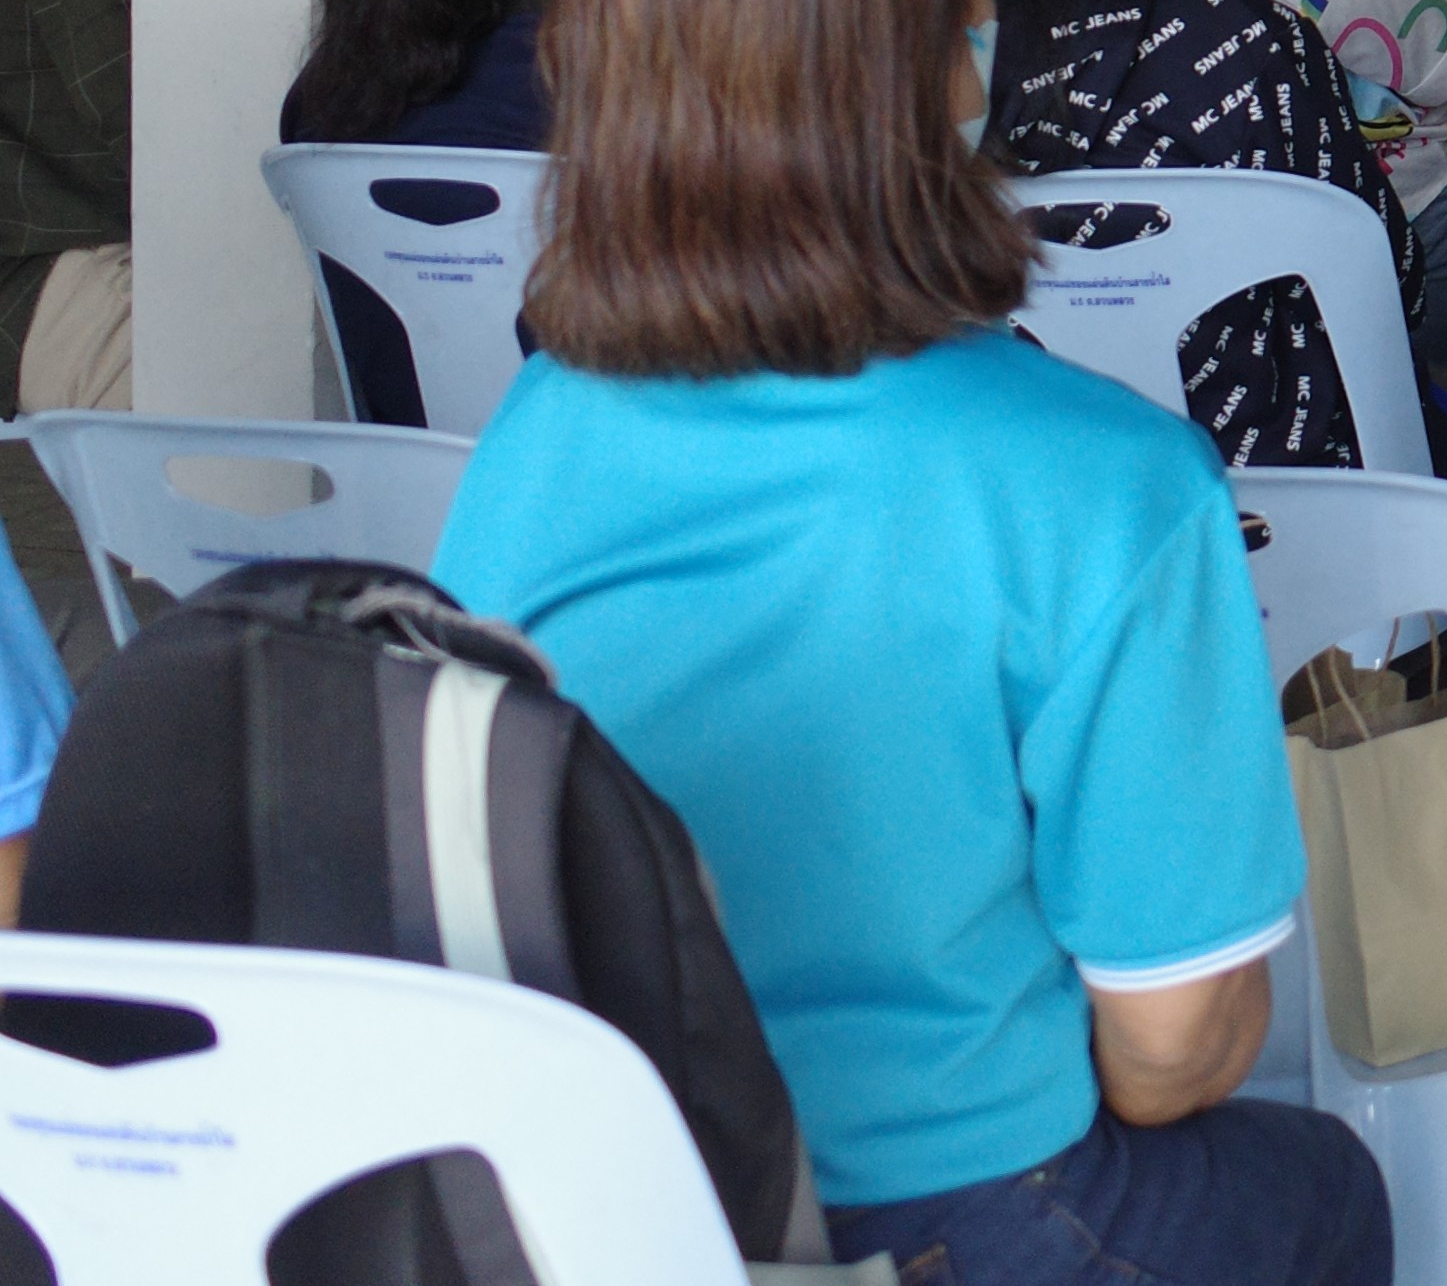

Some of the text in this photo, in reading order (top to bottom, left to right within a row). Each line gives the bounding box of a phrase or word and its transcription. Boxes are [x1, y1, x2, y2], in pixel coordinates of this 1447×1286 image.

[1050, 7, 1143, 41] MC JEANS
[1137, 17, 1187, 61] JEANS
[1193, 18, 1269, 76] MC JEANS
[1020, 61, 1076, 95] JEANS
[1068, 89, 1098, 109] MC
[1190, 76, 1259, 136] MC JEAN
[1276, 82, 1294, 138] JEANS
[1038, 119, 1064, 138] MC
[1104, 91, 1171, 148] MC JEAN
[1215, 324, 1234, 353] MC
[1251, 329, 1268, 358] MC
[1290, 322, 1306, 349] MC
[1212, 383, 1248, 433] JEANS
[1286, 375, 1312, 452] MC JEANS
